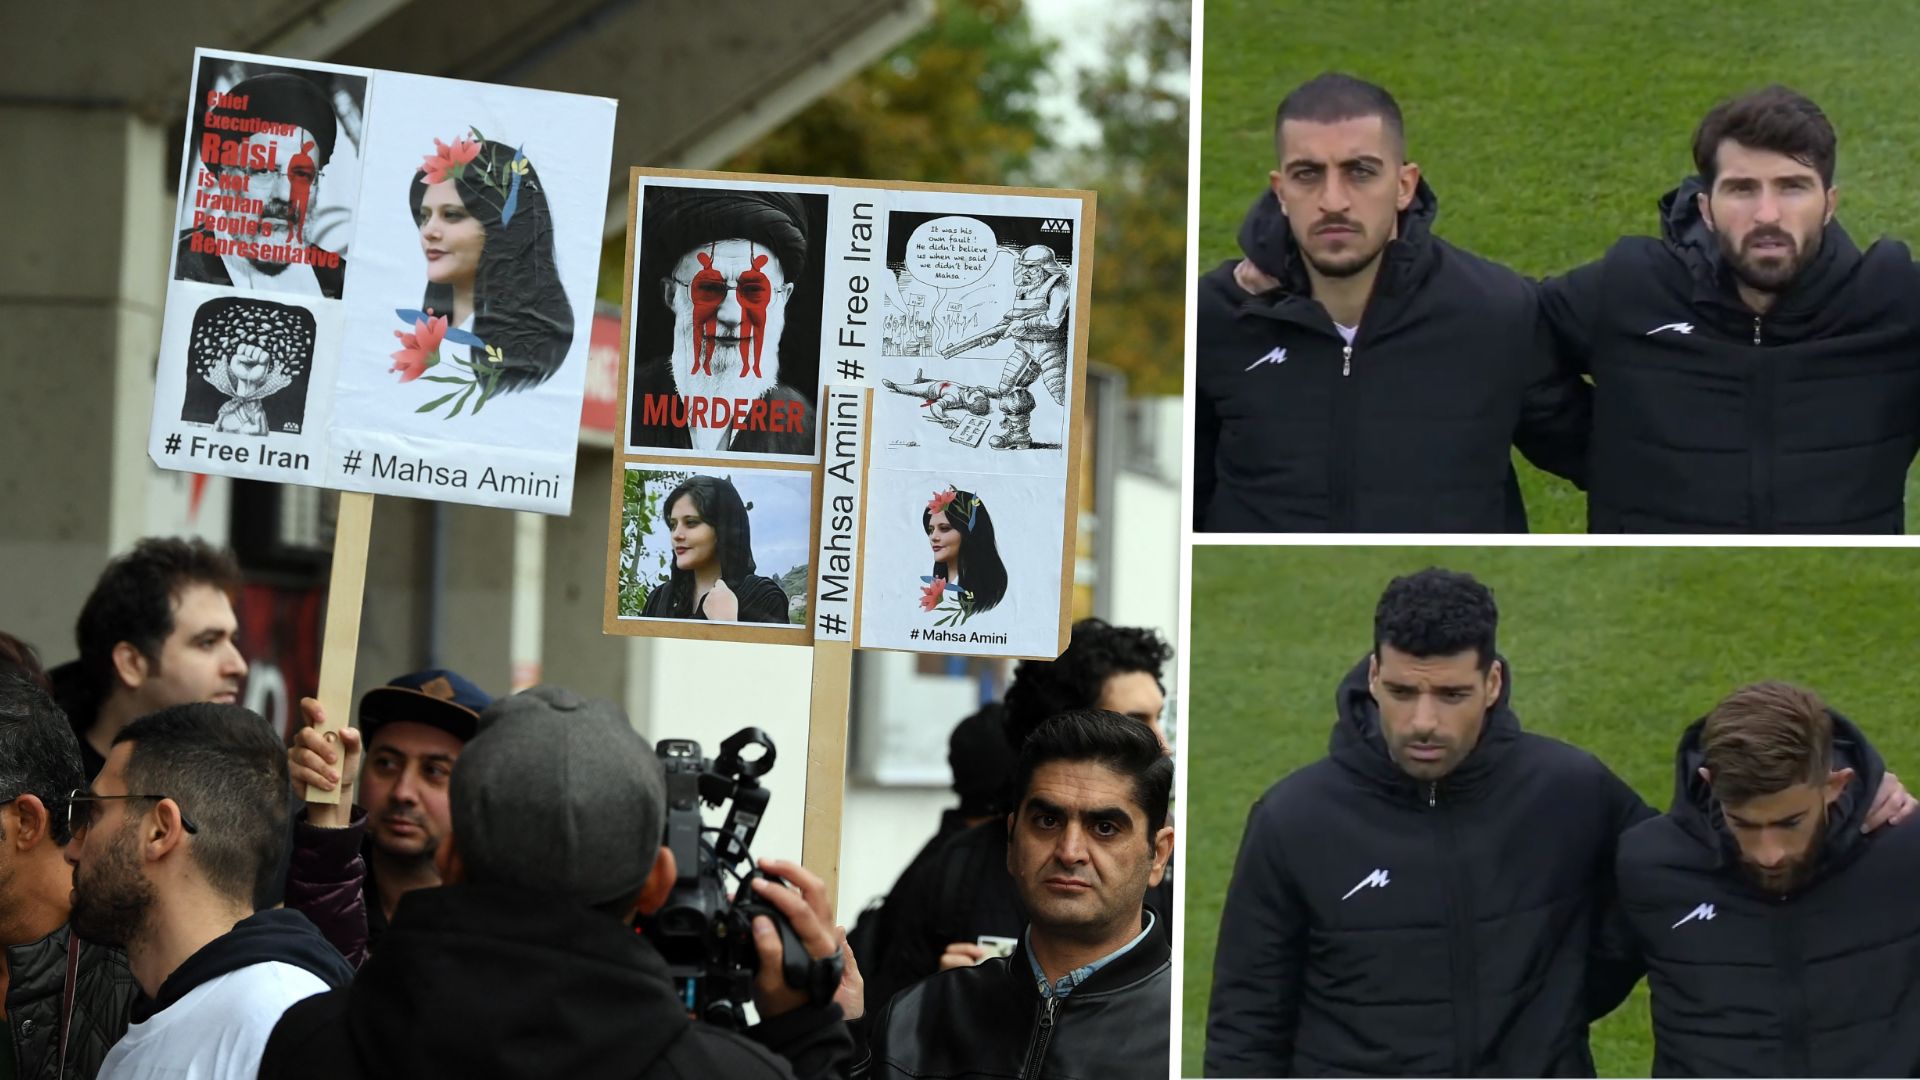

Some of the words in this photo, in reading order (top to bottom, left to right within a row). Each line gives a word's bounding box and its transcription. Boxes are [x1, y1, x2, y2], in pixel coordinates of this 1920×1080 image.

[207, 89, 249, 111] Chief
[204, 111, 297, 137] Executioner
[201, 132, 278, 172] Raisi
[198, 168, 215, 188] is
[218, 171, 250, 192] not
[195, 189, 264, 215] Iranian
[193, 210, 273, 238] People's
[843, 202, 874, 262] Iran
[190, 232, 340, 269] Representative
[929, 244, 955, 252] didn't
[958, 245, 988, 253] believe
[949, 235, 971, 244] fault
[935, 262, 960, 270] didn't
[964, 263, 981, 271] beat
[838, 275, 870, 347] Free
[837, 359, 865, 380] #
[643, 393, 805, 433] MURDERER
[165, 433, 182, 455] #
[190, 436, 249, 463] Free
[258, 443, 310, 470] Iran
[828, 393, 858, 484] Amini
[342, 449, 362, 475] #
[371, 453, 467, 488] Mahsa
[477, 466, 560, 499] Amini
[820, 495, 853, 602] Mahsa
[819, 613, 847, 634] #
[910, 628, 920, 640] #
[922, 629, 966, 642] Mahsa
[969, 631, 1007, 645] Amini
